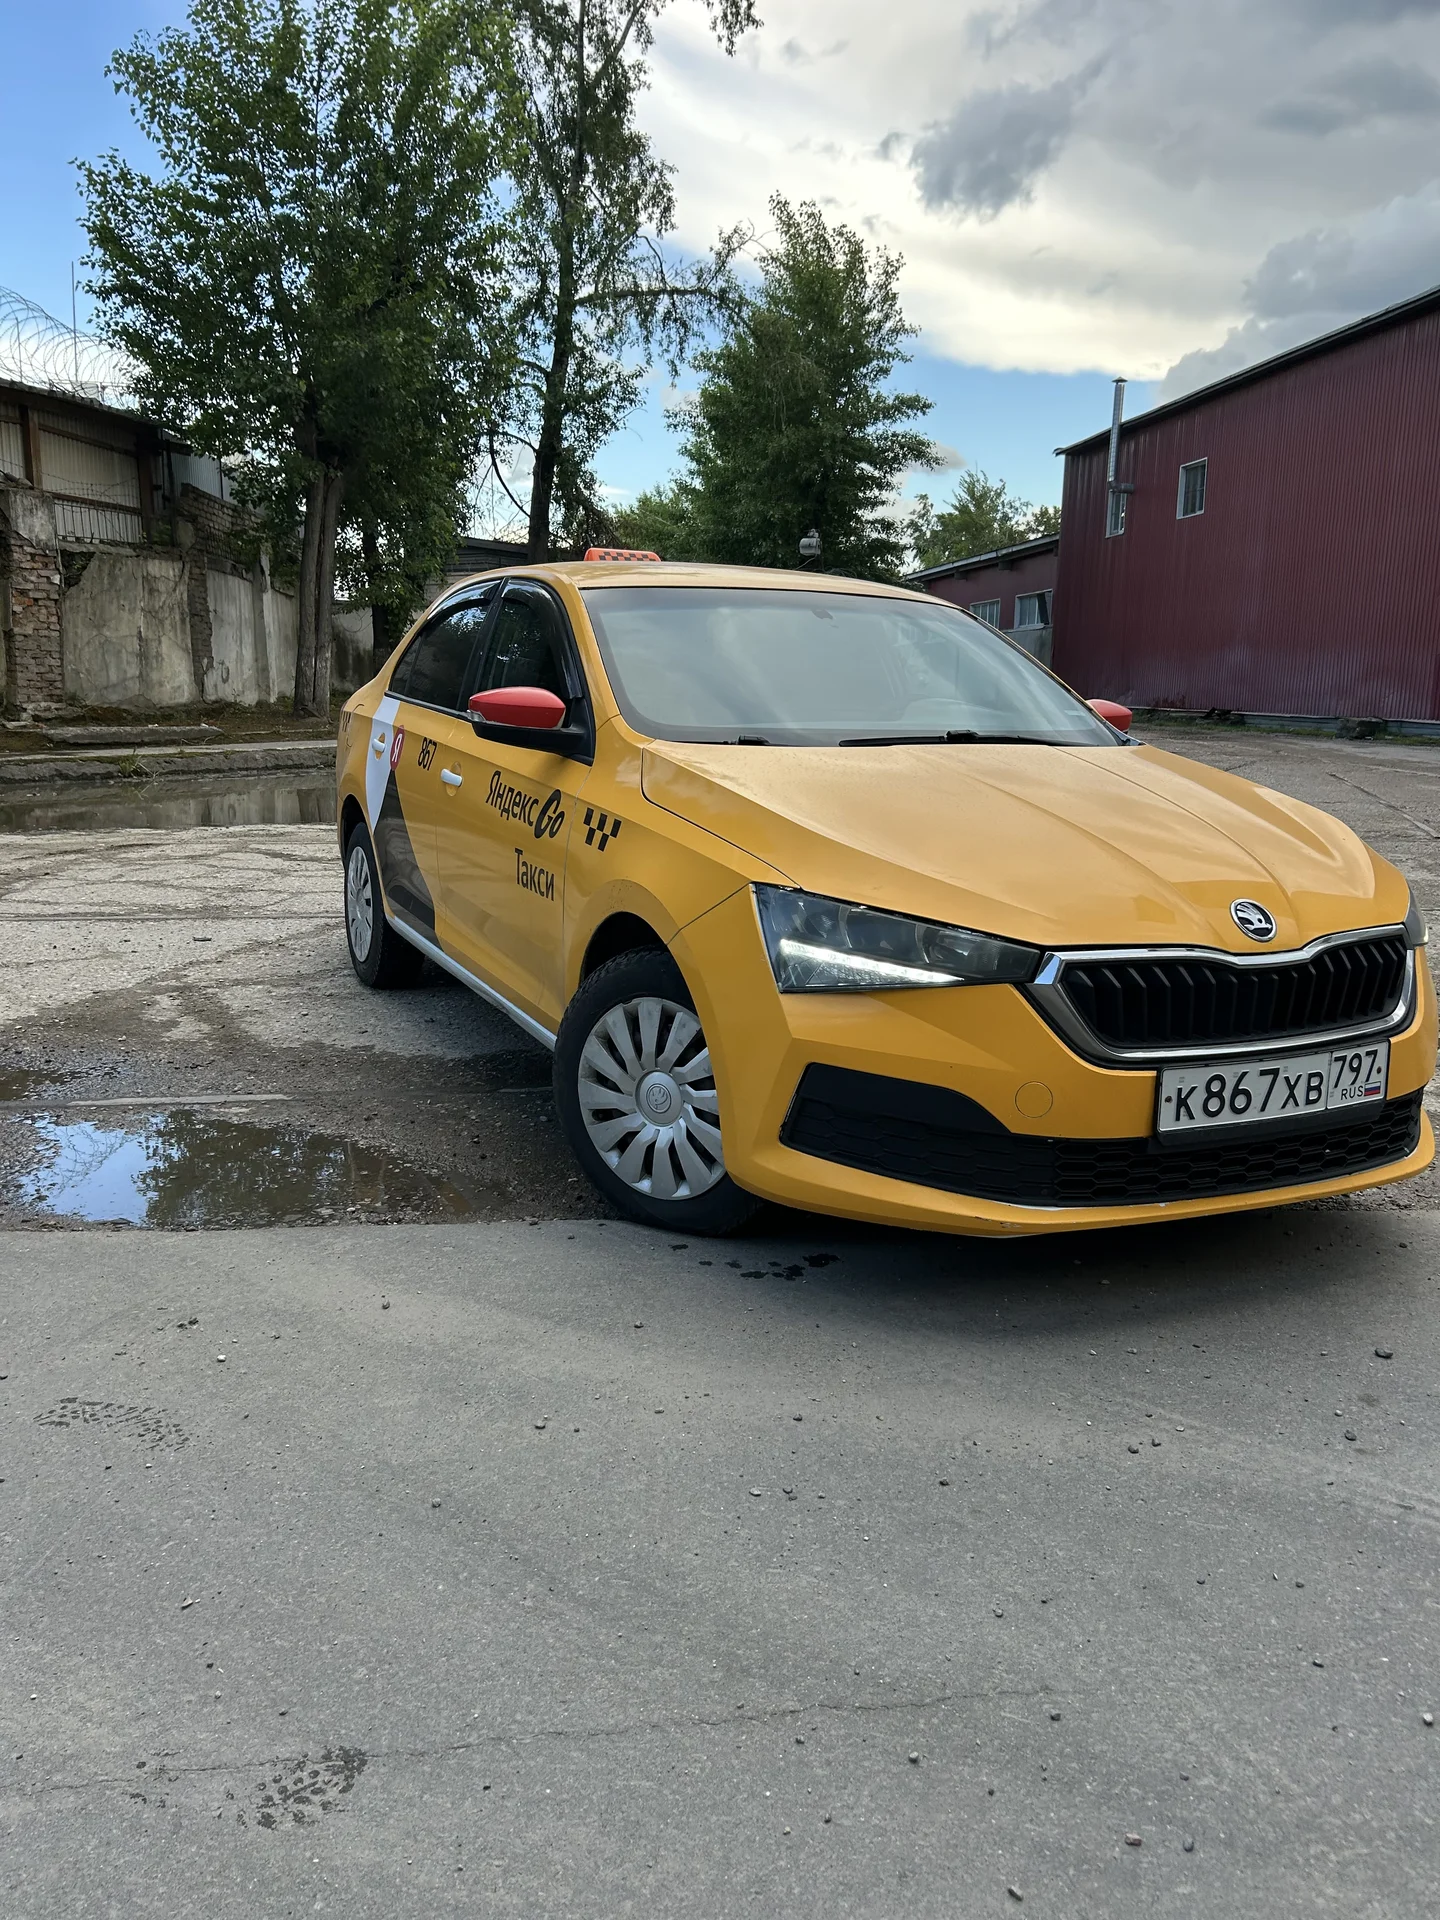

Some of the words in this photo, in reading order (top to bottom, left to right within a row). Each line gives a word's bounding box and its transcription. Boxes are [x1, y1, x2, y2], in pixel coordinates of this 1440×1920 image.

[391, 733, 403, 763] Я
[417, 736, 438, 771] 867
[514, 847, 555, 902] Такси
[1333, 1048, 1379, 1089] 797
[1340, 1084, 1364, 1101] RUS
